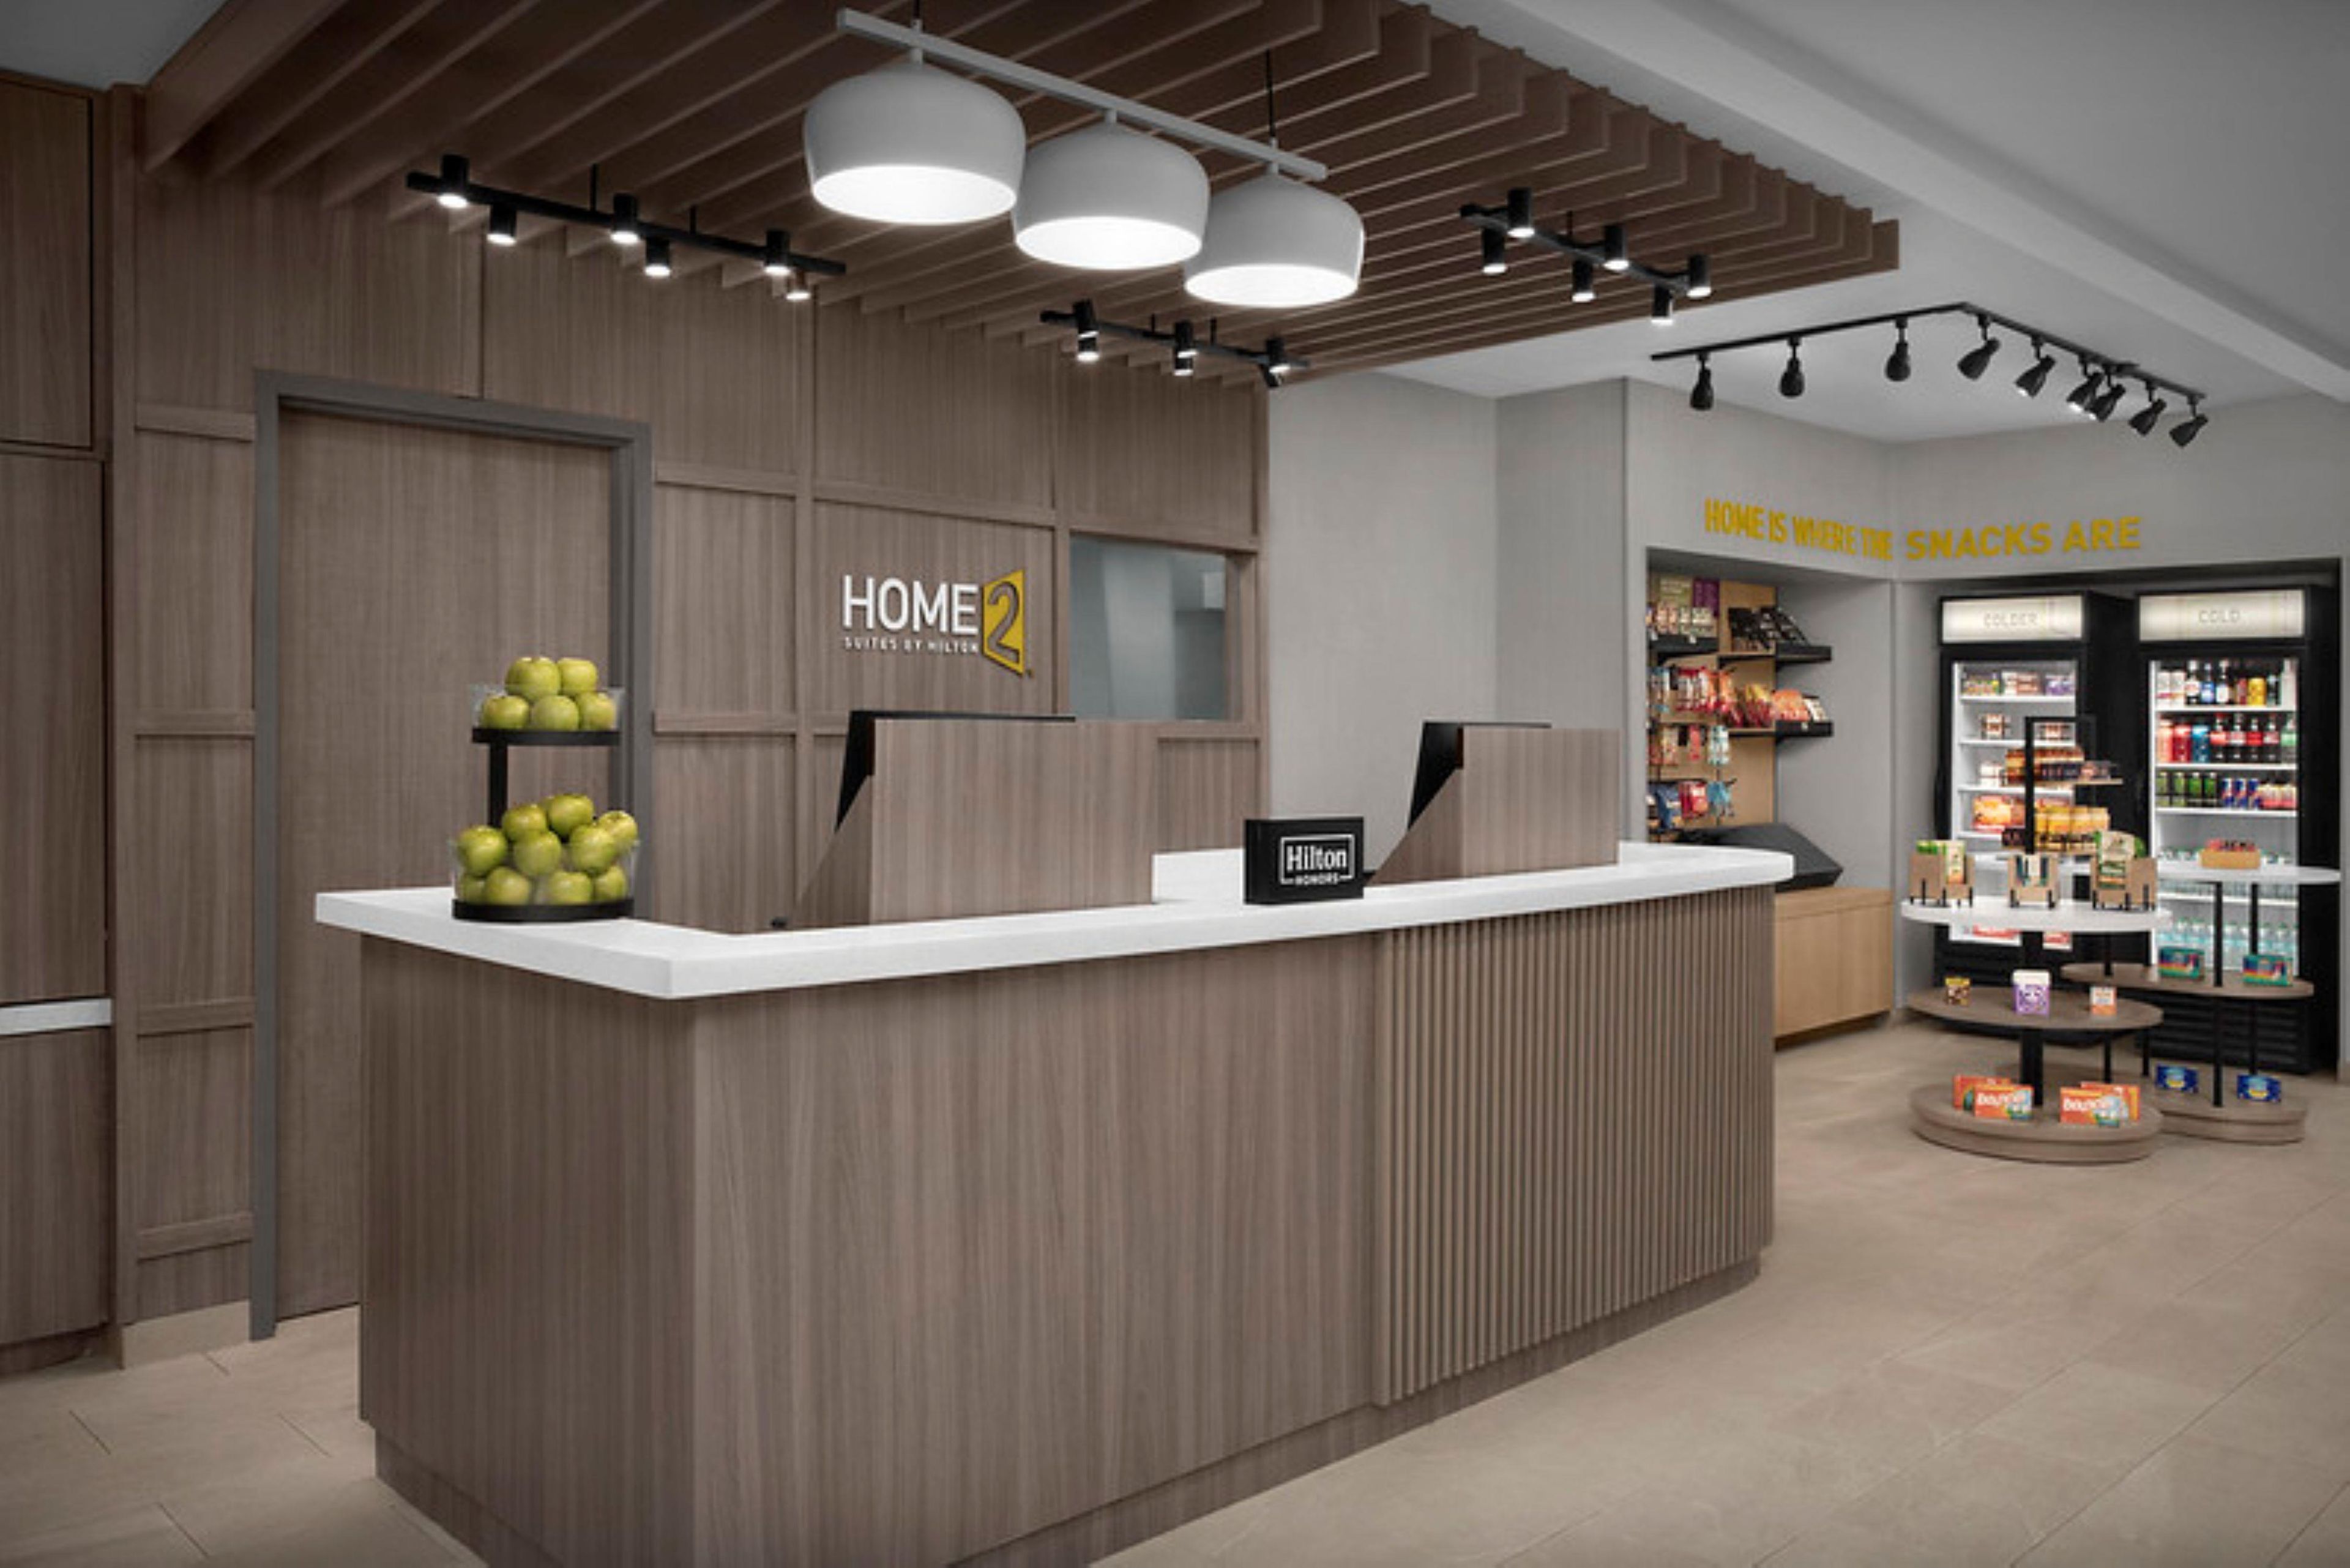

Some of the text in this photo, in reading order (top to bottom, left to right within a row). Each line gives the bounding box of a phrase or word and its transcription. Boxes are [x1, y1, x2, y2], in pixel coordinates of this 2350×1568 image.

[1704, 498, 2141, 561] HOME IS WHERE THE SNACKS ARE
[2198, 610, 2240, 623] COLD
[1286, 845, 1347, 872] Hilton
